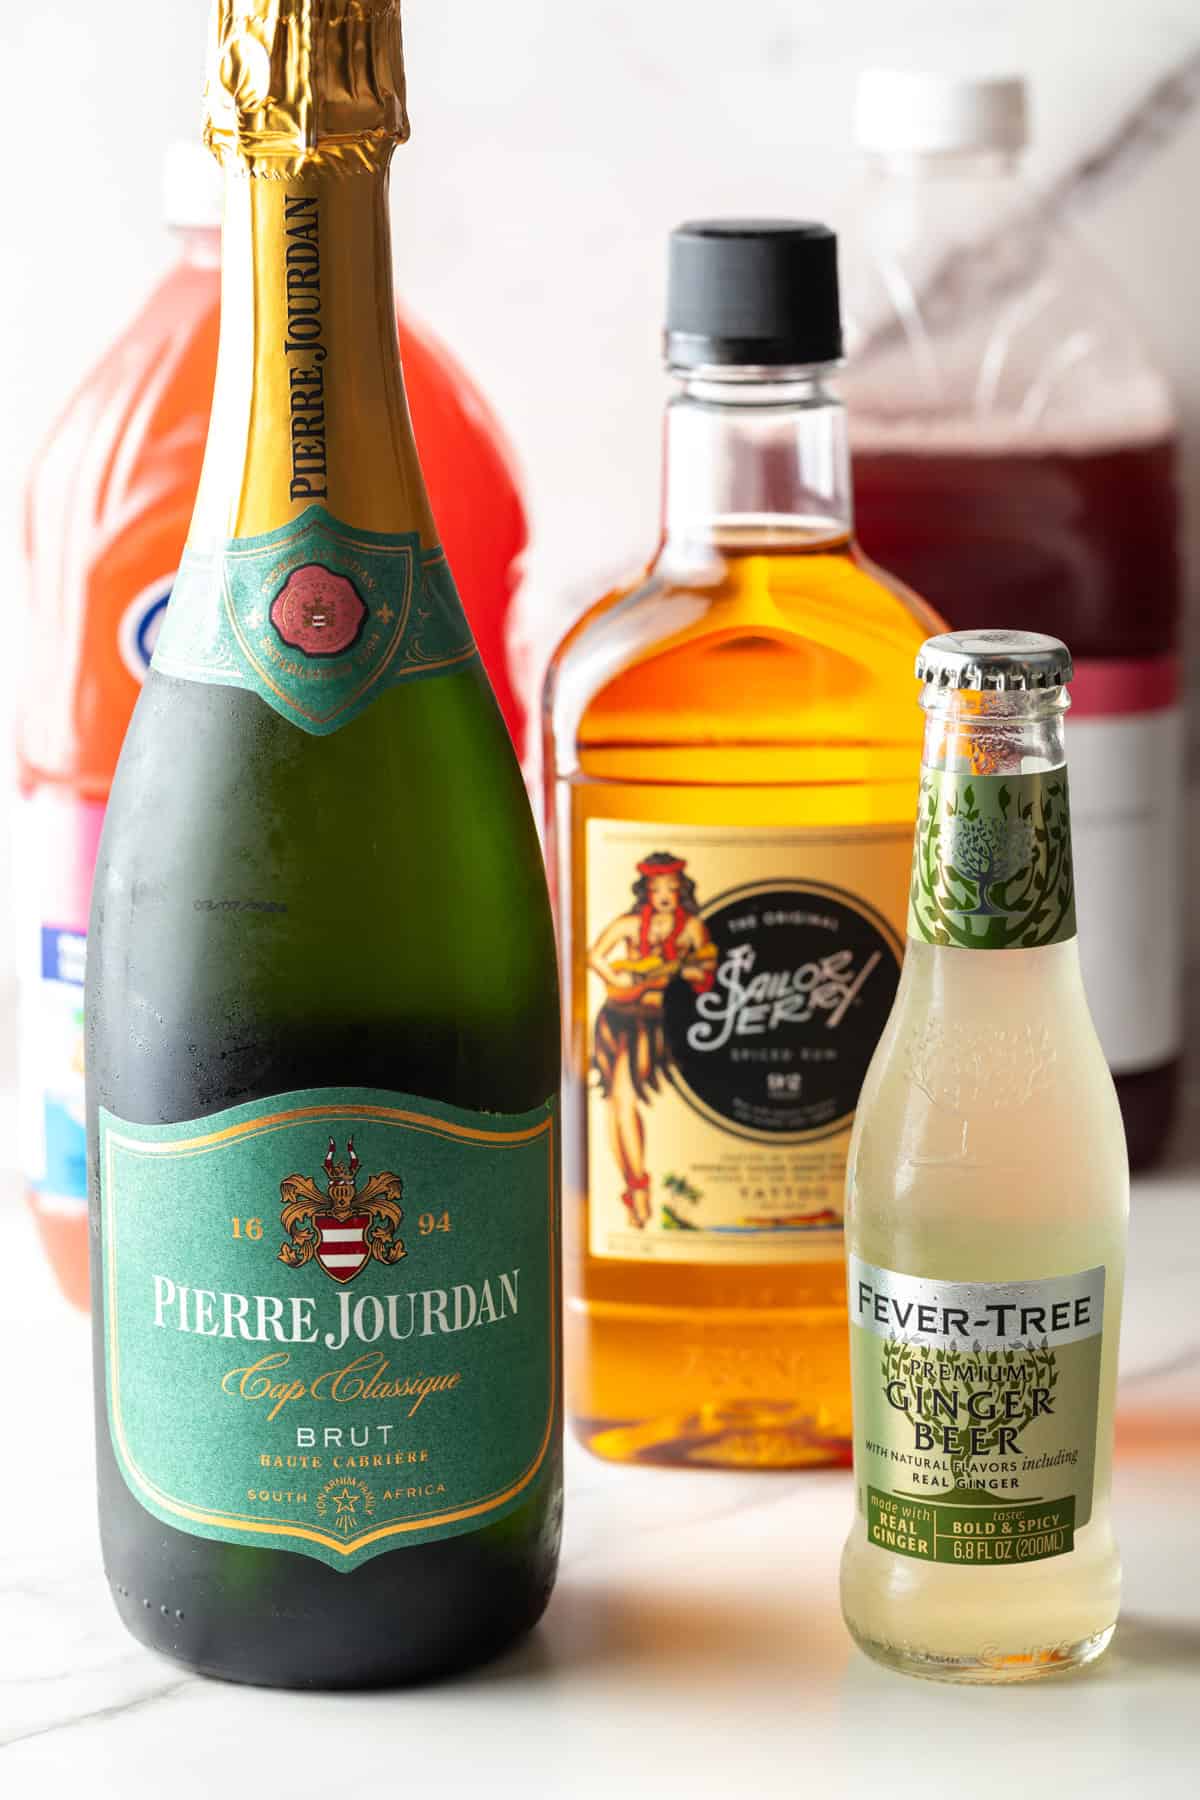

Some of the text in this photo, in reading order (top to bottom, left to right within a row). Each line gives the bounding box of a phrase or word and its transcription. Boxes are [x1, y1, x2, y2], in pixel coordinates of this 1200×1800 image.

[284, 193, 328, 503] PIERRE JOURDAN
[230, 1212, 453, 1241] 16 94
[151, 1268, 521, 1351] PIERRE JOURDAN
[857, 1280, 1092, 1337] FEVER-TREE
[909, 1359, 1028, 1382] PREMIUM
[221, 1351, 463, 1421] Cap Classique
[886, 1381, 1055, 1421] GINGER
[297, 1424, 394, 1448] BRUT
[914, 1422, 1023, 1457] BEER
[259, 1453, 323, 1469] HAUTE
[865, 1439, 1079, 1474] WITH NATURAL FLAVORS including
[247, 1483, 447, 1503] SOUTH AFRICA
[912, 1473, 1020, 1490] REAL GINGER
[871, 1495, 930, 1521] made with
[880, 1511, 917, 1536] REAL
[952, 1513, 1060, 1535] BOLD & SPICY
[873, 1525, 929, 1554] GINGER
[953, 1528, 1064, 1560] 6.8 FL OZ (200ML)
